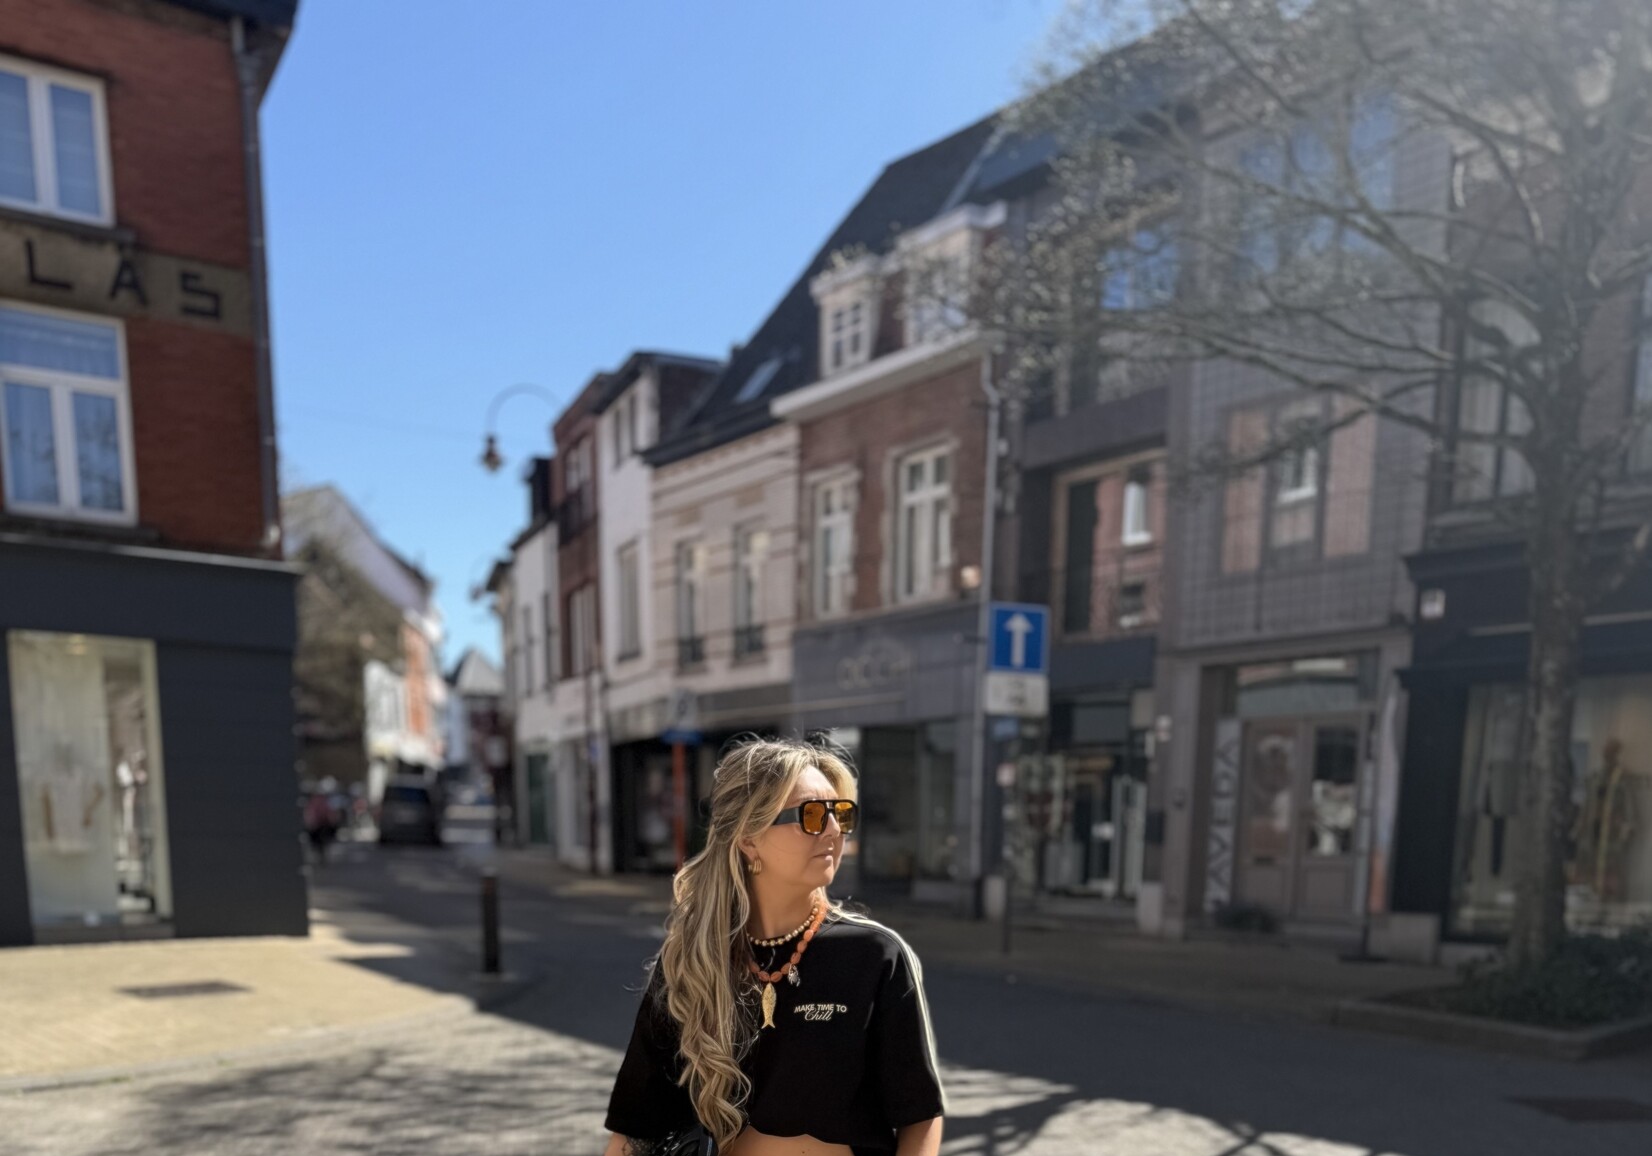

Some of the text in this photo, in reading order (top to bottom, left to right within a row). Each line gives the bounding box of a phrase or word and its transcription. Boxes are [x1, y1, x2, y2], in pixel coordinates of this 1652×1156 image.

[794, 1004, 815, 1013] MAKE
[836, 1004, 847, 1013] TO
[804, 1008, 834, 1021] Chill
